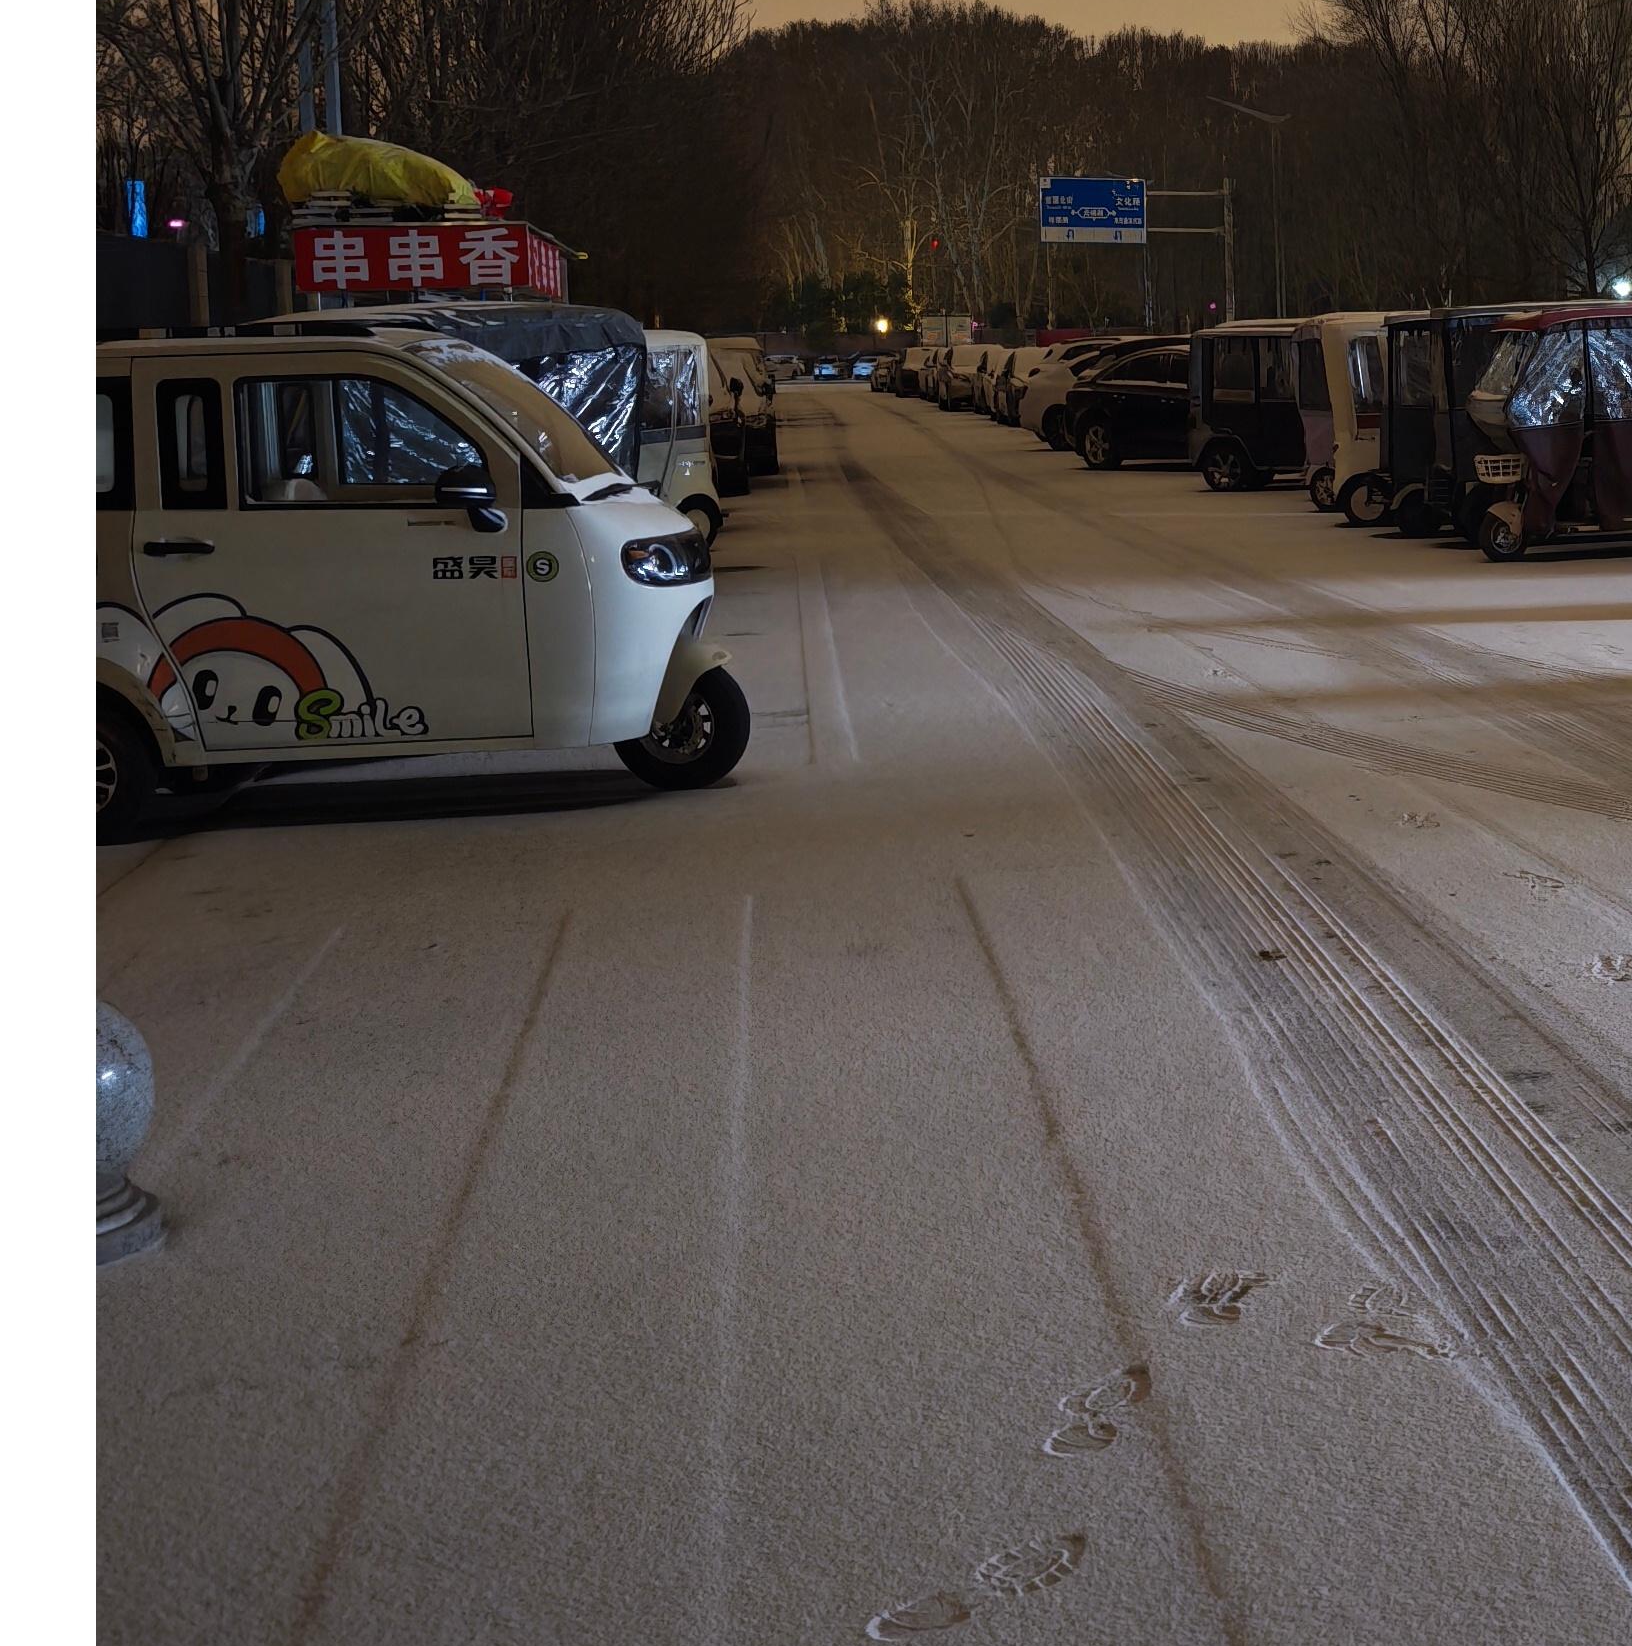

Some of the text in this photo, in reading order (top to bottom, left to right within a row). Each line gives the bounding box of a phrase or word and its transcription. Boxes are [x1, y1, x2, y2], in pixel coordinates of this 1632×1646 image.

[312, 227, 520, 289] 串串香
[433, 556, 498, 580] 盛昊
